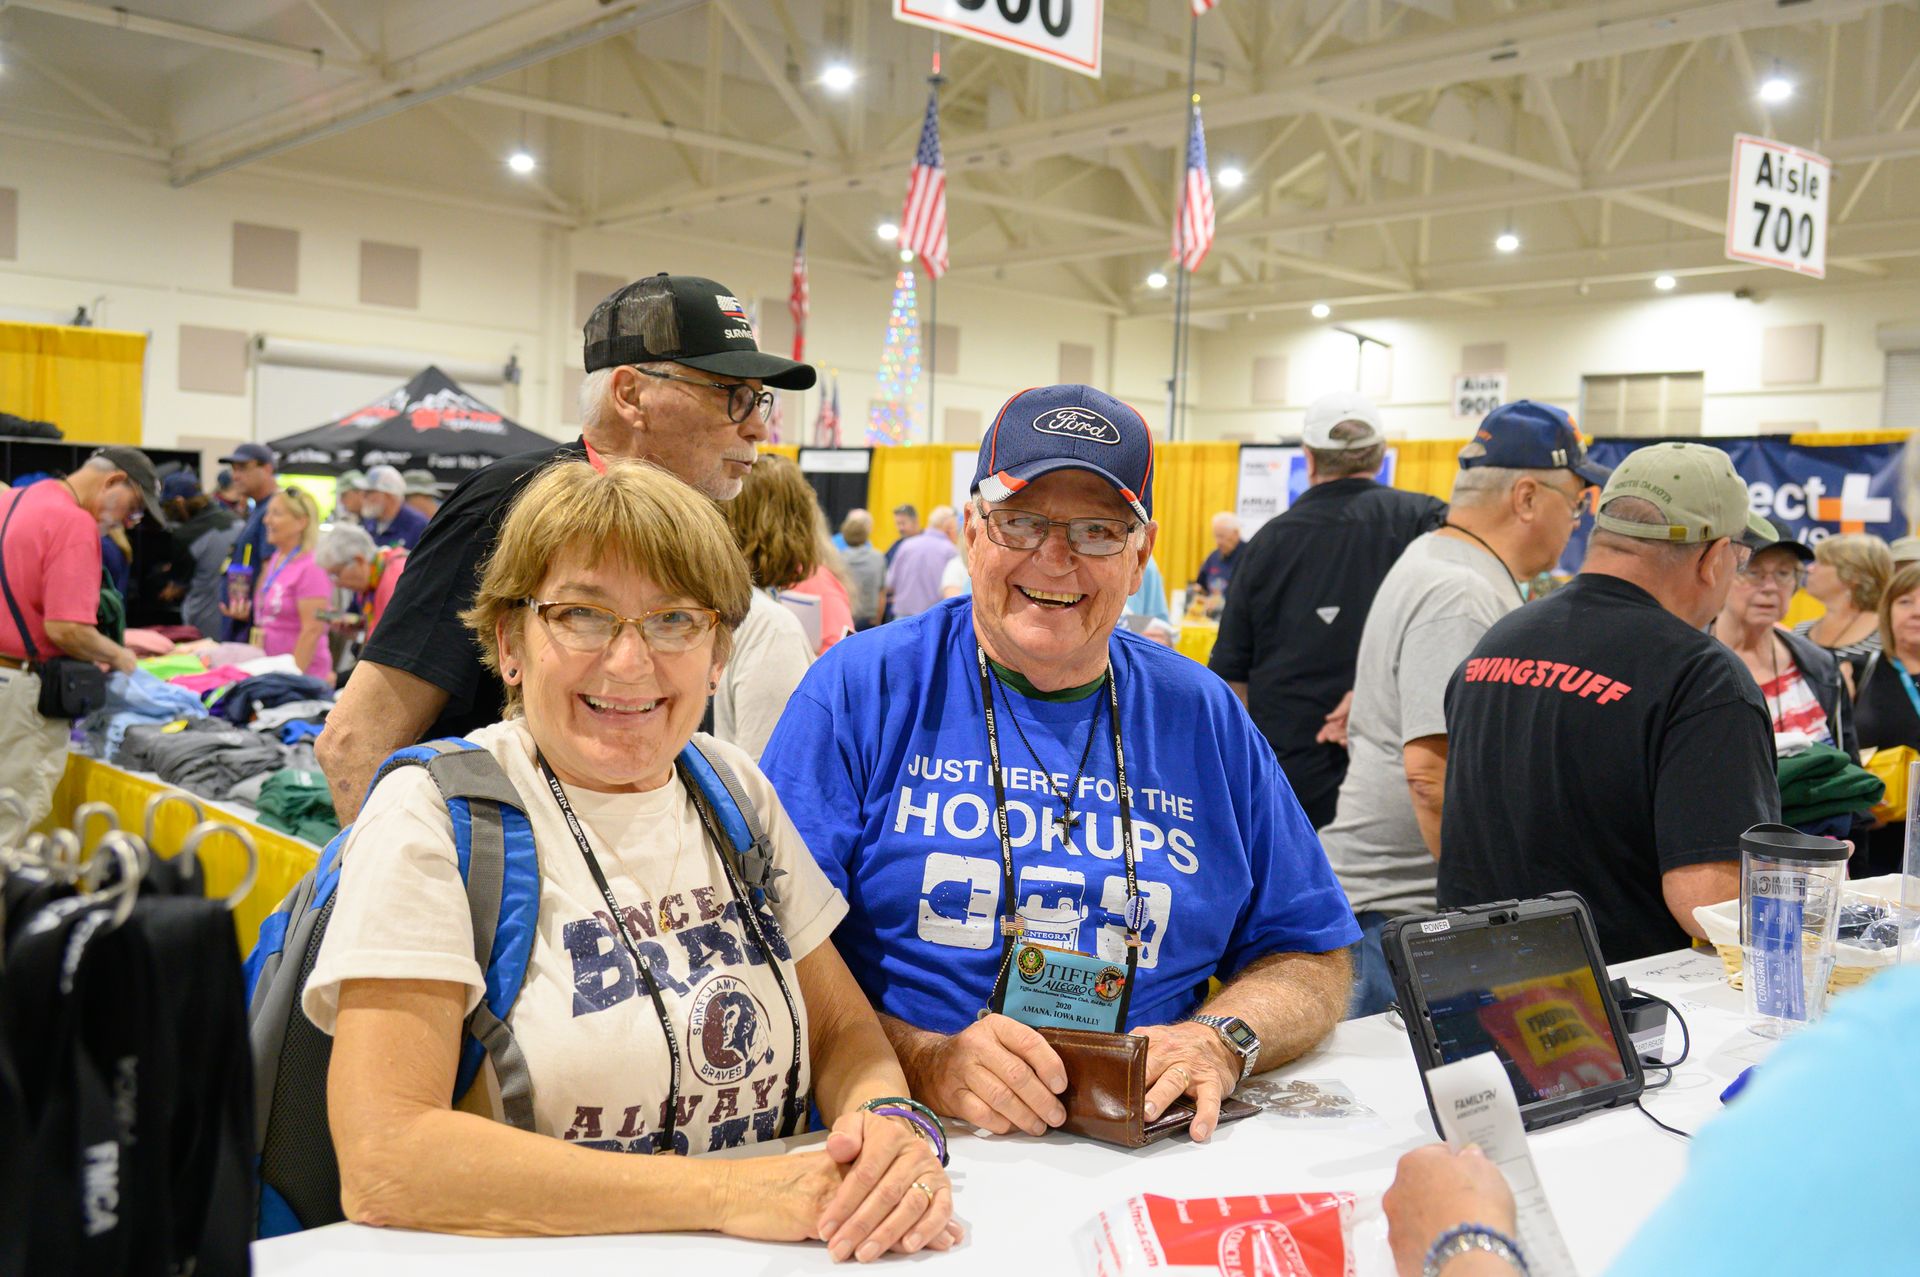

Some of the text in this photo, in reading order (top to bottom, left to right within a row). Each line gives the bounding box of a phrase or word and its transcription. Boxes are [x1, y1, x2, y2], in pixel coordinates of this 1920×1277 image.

[1755, 151, 1820, 200] Aisle
[1753, 200, 1814, 259] 700
[1463, 376, 1500, 391] Aisle
[1460, 396, 1500, 416] 900
[1048, 410, 1107, 438] Ford
[1641, 479, 1673, 506] DAKOTA
[1750, 475, 1827, 521] ect
[1465, 656, 1633, 705] WINGSTUFF
[986, 708, 996, 736] TIFFIN
[908, 754, 1195, 822] JUST HERE FOR THE
[1120, 771, 1128, 800] TIFFIN
[550, 777, 569, 810] TIFFIN
[577, 835, 590, 853] Club
[999, 805, 1010, 835] TIFFIN
[894, 785, 1200, 875] HOOKUPS
[591, 885, 726, 942] ONCE
[604, 888, 625, 923] TIFFIN
[1133, 896, 1144, 929] Grandpa
[1023, 929, 1069, 942] ENTEGRA
[1423, 920, 1449, 932] POWER
[1042, 979, 1087, 996] ALLEGRO
[1046, 963, 1096, 986] TIFF
[1755, 949, 1768, 1003] CONGRATS
[1022, 1004, 1100, 1026] AMANA, IOWA RALLY
[1055, 1001, 1072, 1010] 2020
[662, 1015, 679, 1054] TIFFIN
[700, 1063, 743, 1082] BRAVES
